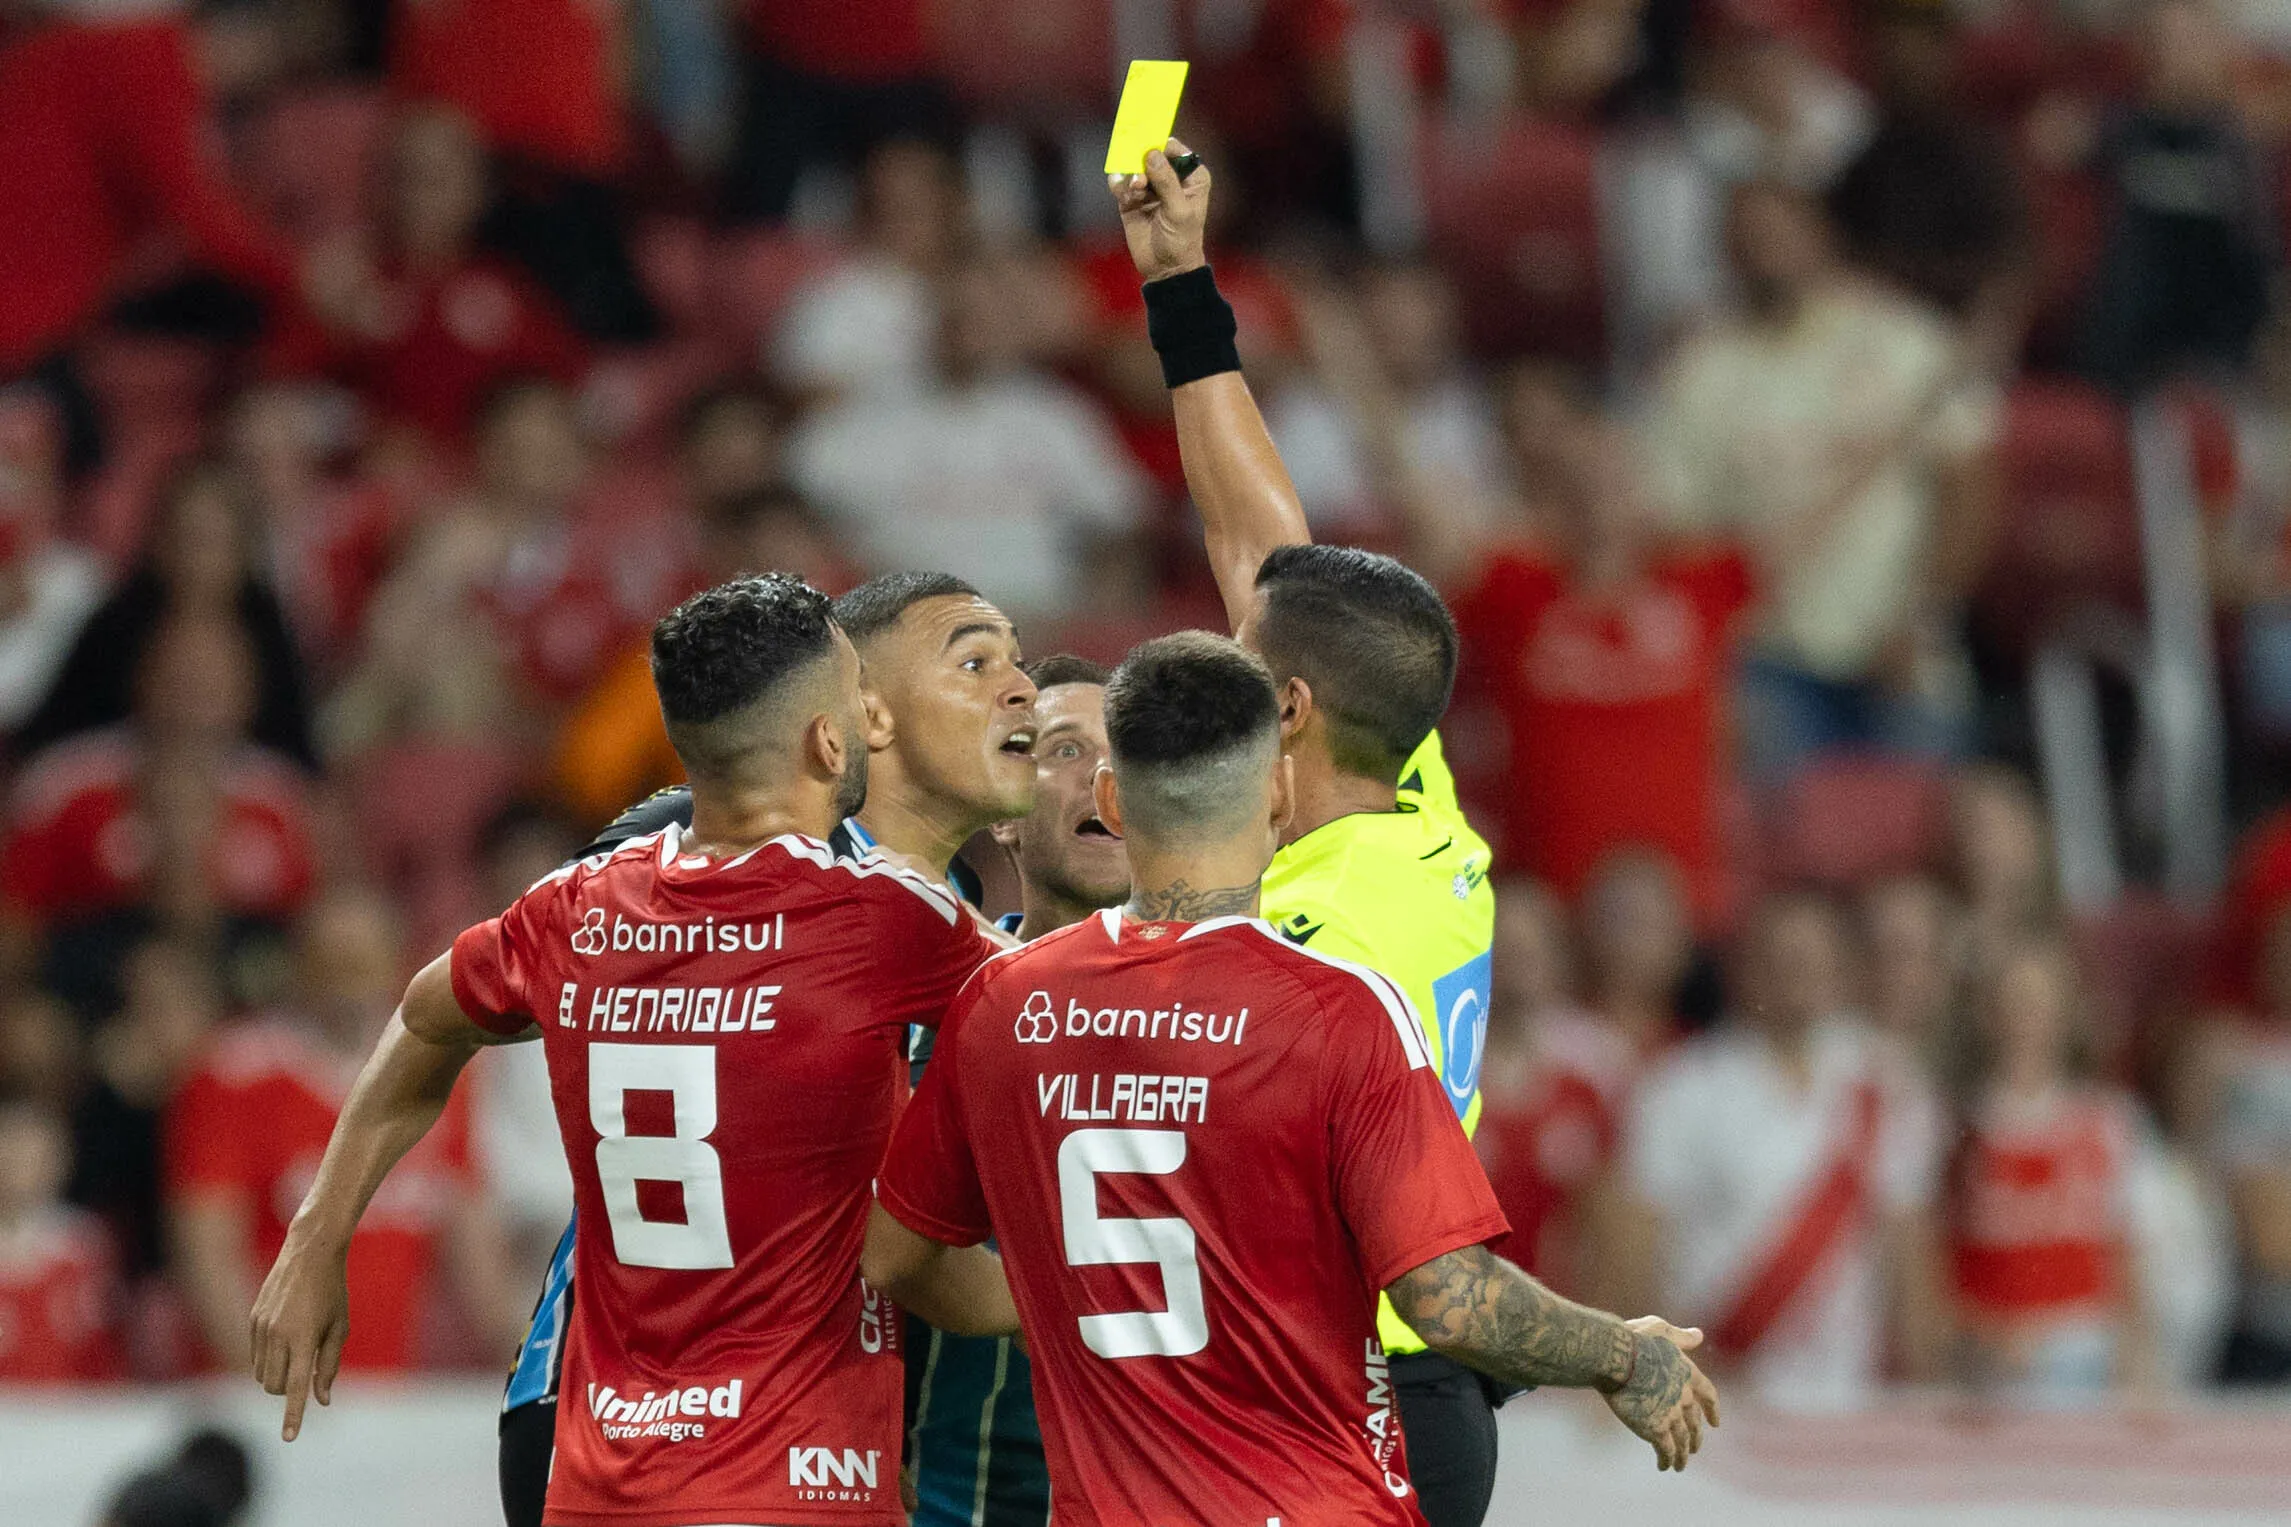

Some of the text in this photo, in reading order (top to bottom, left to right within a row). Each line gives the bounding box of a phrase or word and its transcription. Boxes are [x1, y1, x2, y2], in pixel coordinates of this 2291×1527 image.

[612, 913, 783, 953] banrisul
[588, 985, 782, 1033] HENRIQUE
[1066, 998, 1248, 1045] banrisul
[1037, 1073, 1209, 1124] VILLAGRA
[588, 1042, 735, 1270] 8
[1058, 1128, 1209, 1359] 5
[602, 1421, 705, 1442] Porto Alegre
[789, 1447, 878, 1488] KNN
[798, 1489, 871, 1502] IDIOMAS
